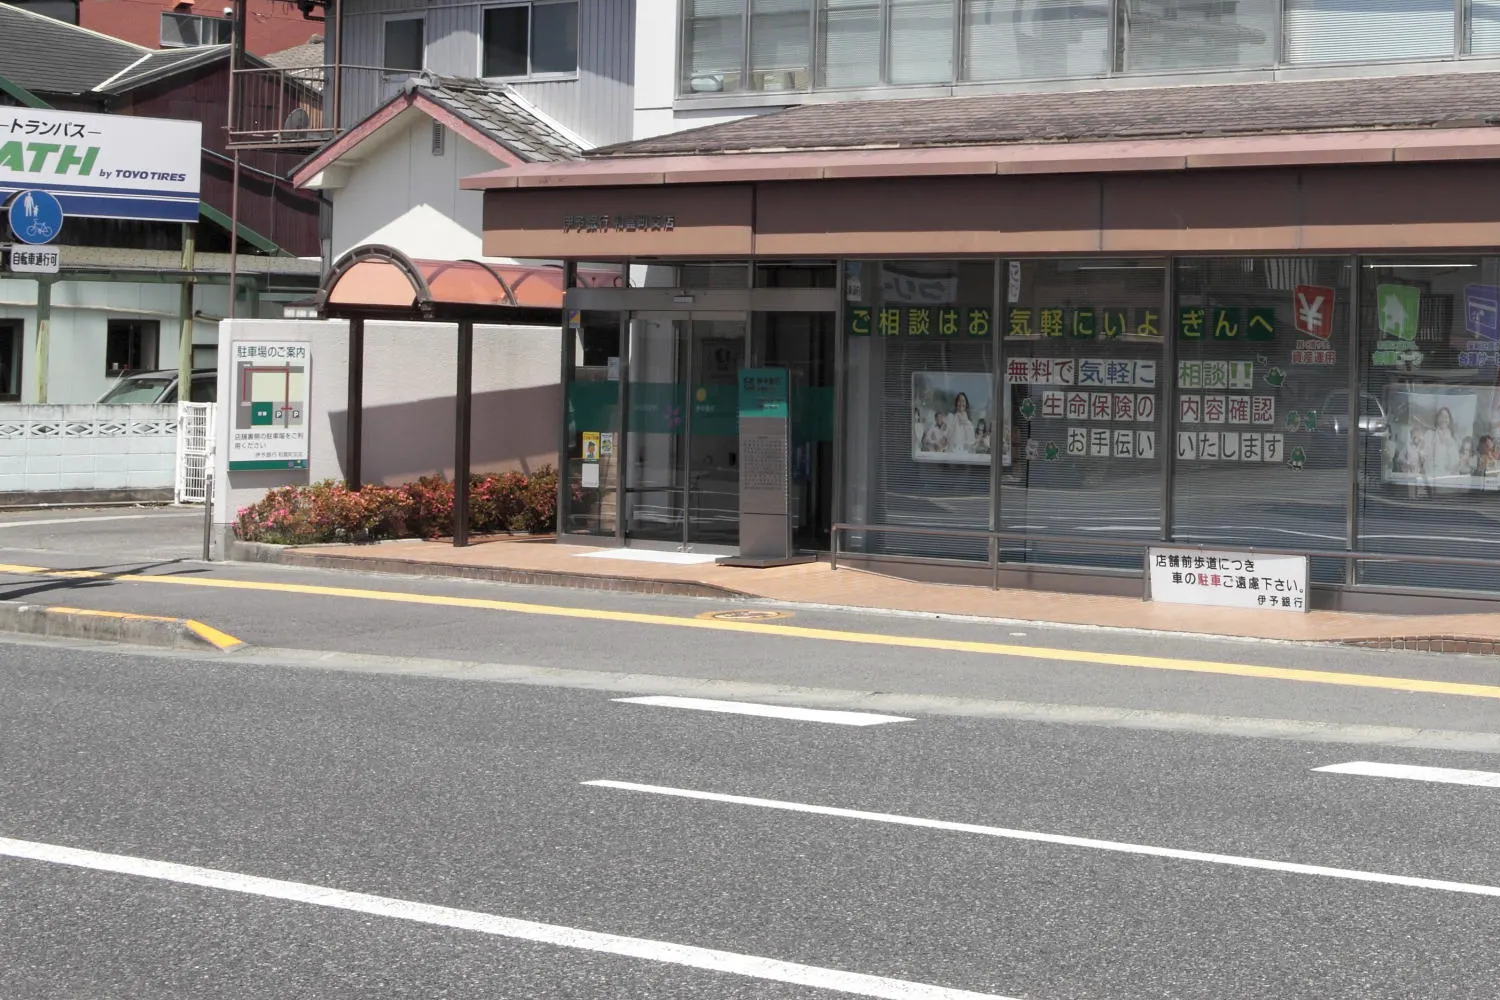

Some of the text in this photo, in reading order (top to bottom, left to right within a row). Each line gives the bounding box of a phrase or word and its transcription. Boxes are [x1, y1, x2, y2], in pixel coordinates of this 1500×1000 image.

[99, 168, 187, 182] by TOYO TIRES
[12, 252, 58, 267] 自転車通行可
[237, 345, 306, 359] 駐車場のご案内
[1043, 393, 1273, 422] 生命保険の 内容確認
[1068, 429, 1282, 458] お手伝い いたします
[1155, 554, 1255, 573] 店舗前歩道につき
[1172, 571, 1304, 594] 車の駐車ご遠慮下さい。
[1257, 594, 1304, 609] 伊予銀行
